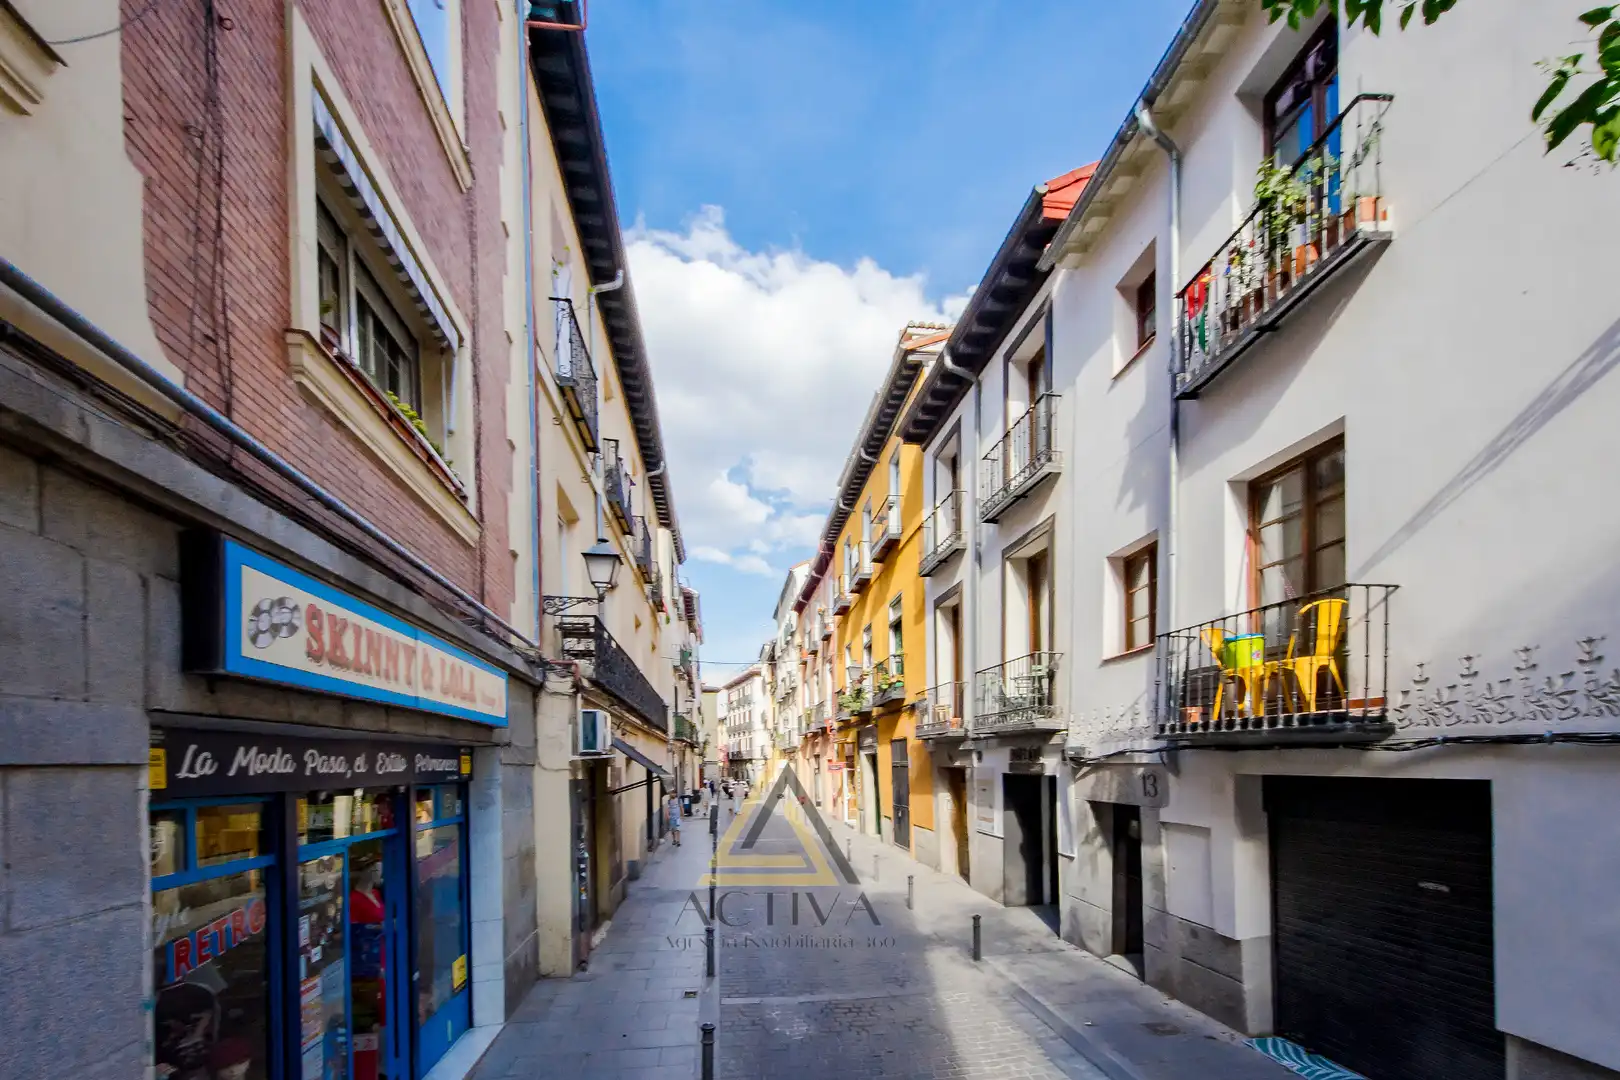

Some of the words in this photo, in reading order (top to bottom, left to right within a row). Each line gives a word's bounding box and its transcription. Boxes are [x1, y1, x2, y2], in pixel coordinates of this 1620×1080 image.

[305, 603, 417, 690] SKINNY
[421, 650, 433, 691] &
[175, 744, 218, 778] La
[227, 746, 297, 776] Moda
[304, 749, 352, 778] Pasa,
[1142, 772, 1159, 798] 13
[166, 899, 266, 982] RETRO
